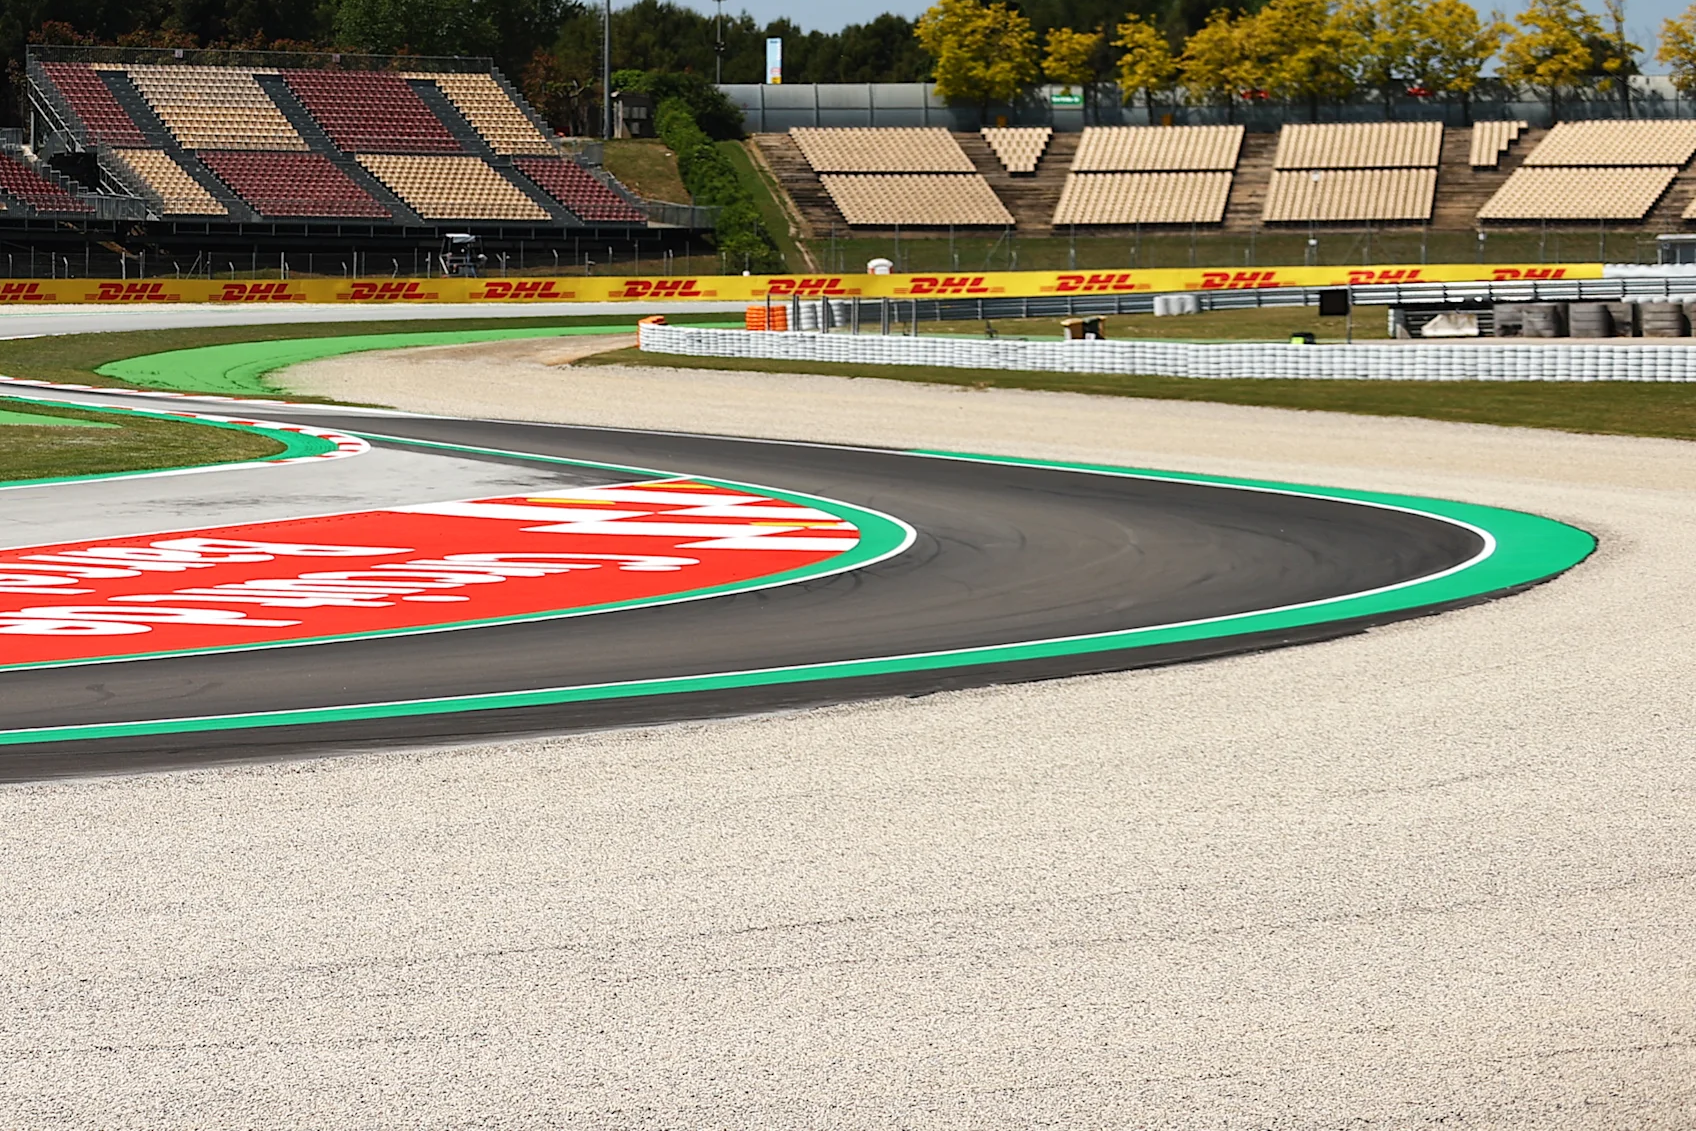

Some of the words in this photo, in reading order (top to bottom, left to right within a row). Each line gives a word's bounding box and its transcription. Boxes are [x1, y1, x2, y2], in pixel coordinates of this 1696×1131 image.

[1055, 274, 1135, 291] DHL
[1202, 271, 1280, 289] DHL
[1348, 269, 1422, 284] DHL
[97, 282, 168, 301] DHL
[221, 283, 293, 300] DHL
[350, 282, 426, 299] DHL
[482, 281, 556, 298] DHL
[623, 280, 701, 297] DHL
[768, 278, 846, 295] DHL
[910, 277, 989, 294] DHL
[108, 553, 699, 607] Circuit
